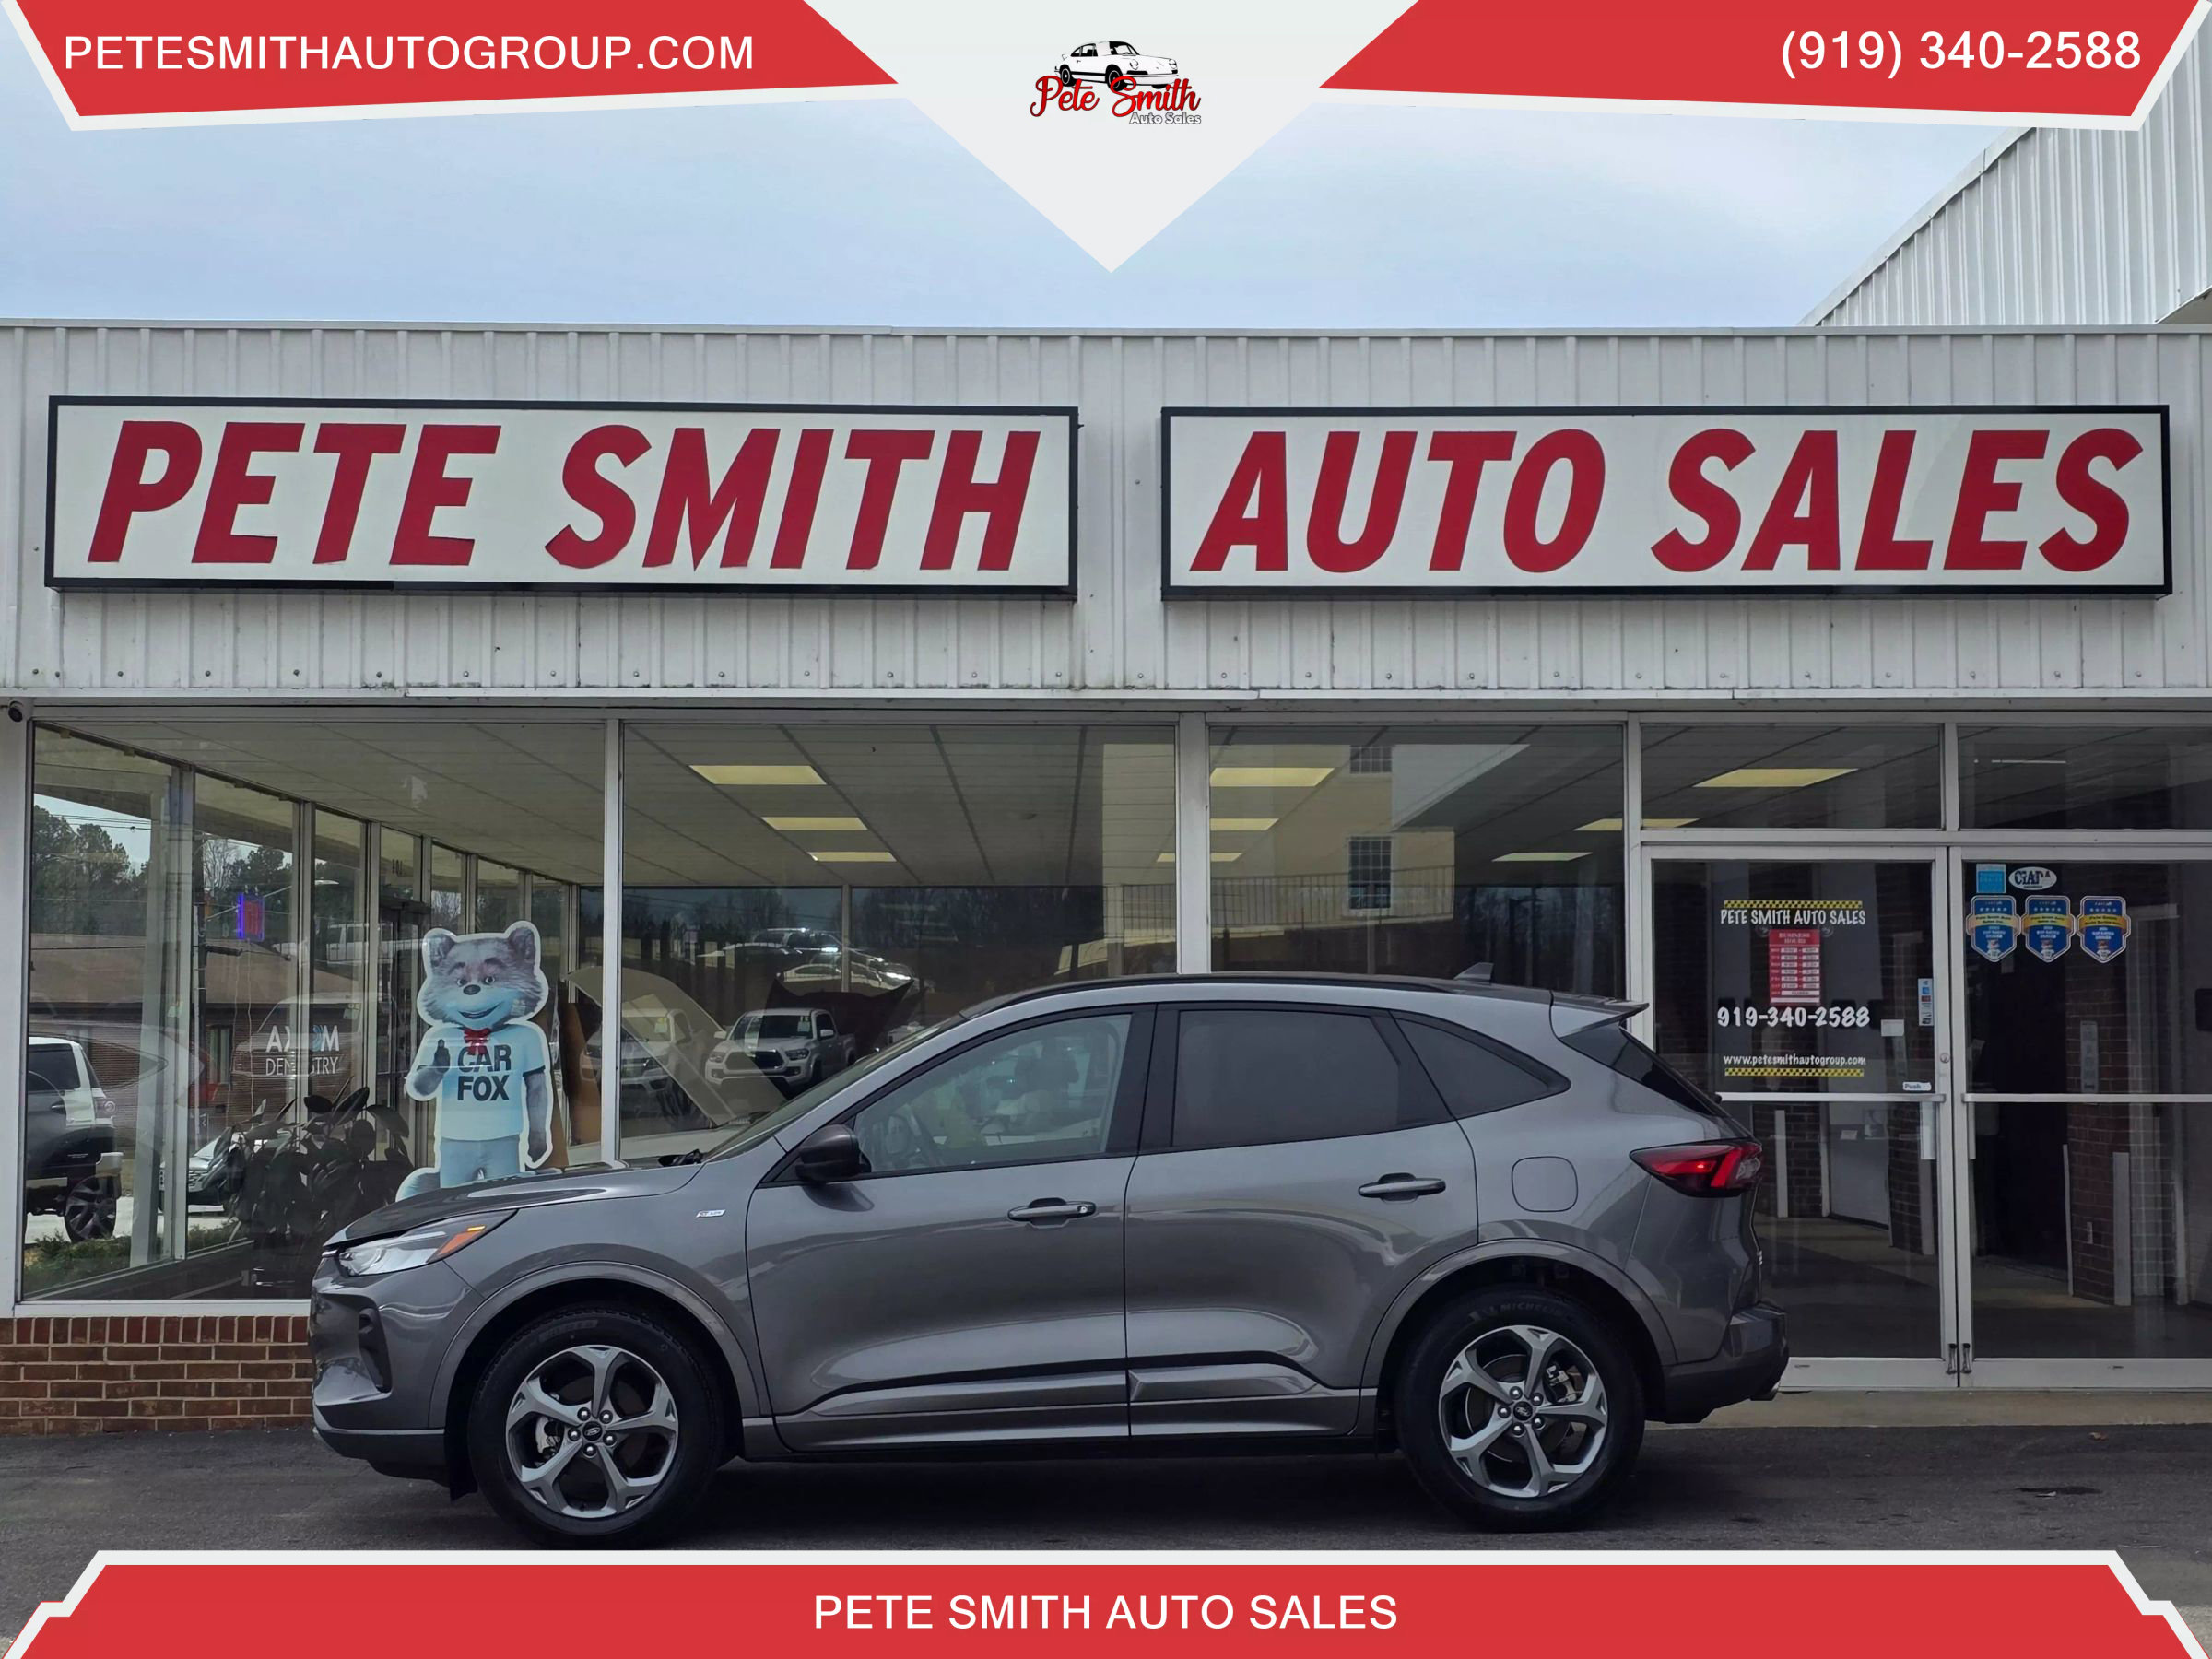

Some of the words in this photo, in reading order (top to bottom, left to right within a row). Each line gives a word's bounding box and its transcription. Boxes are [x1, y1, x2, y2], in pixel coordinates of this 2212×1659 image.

[88, 420, 501, 566] PETE
[545, 424, 1041, 572] SMITH
[1189, 429, 1606, 573] AUTO
[1650, 429, 2143, 573] SALES
[1720, 909, 1747, 924] PETE
[1750, 909, 1791, 924] SMITH
[1794, 909, 1827, 924] AUTO
[1830, 909, 1866, 925] SALES
[1717, 1006, 1870, 1027] 919-340-2588
[265, 1056, 339, 1076] DENTRY
[457, 1044, 512, 1073] CAR
[1723, 1053, 1866, 1067] www.petesmithautogroup.com
[457, 1074, 510, 1101] FOX
